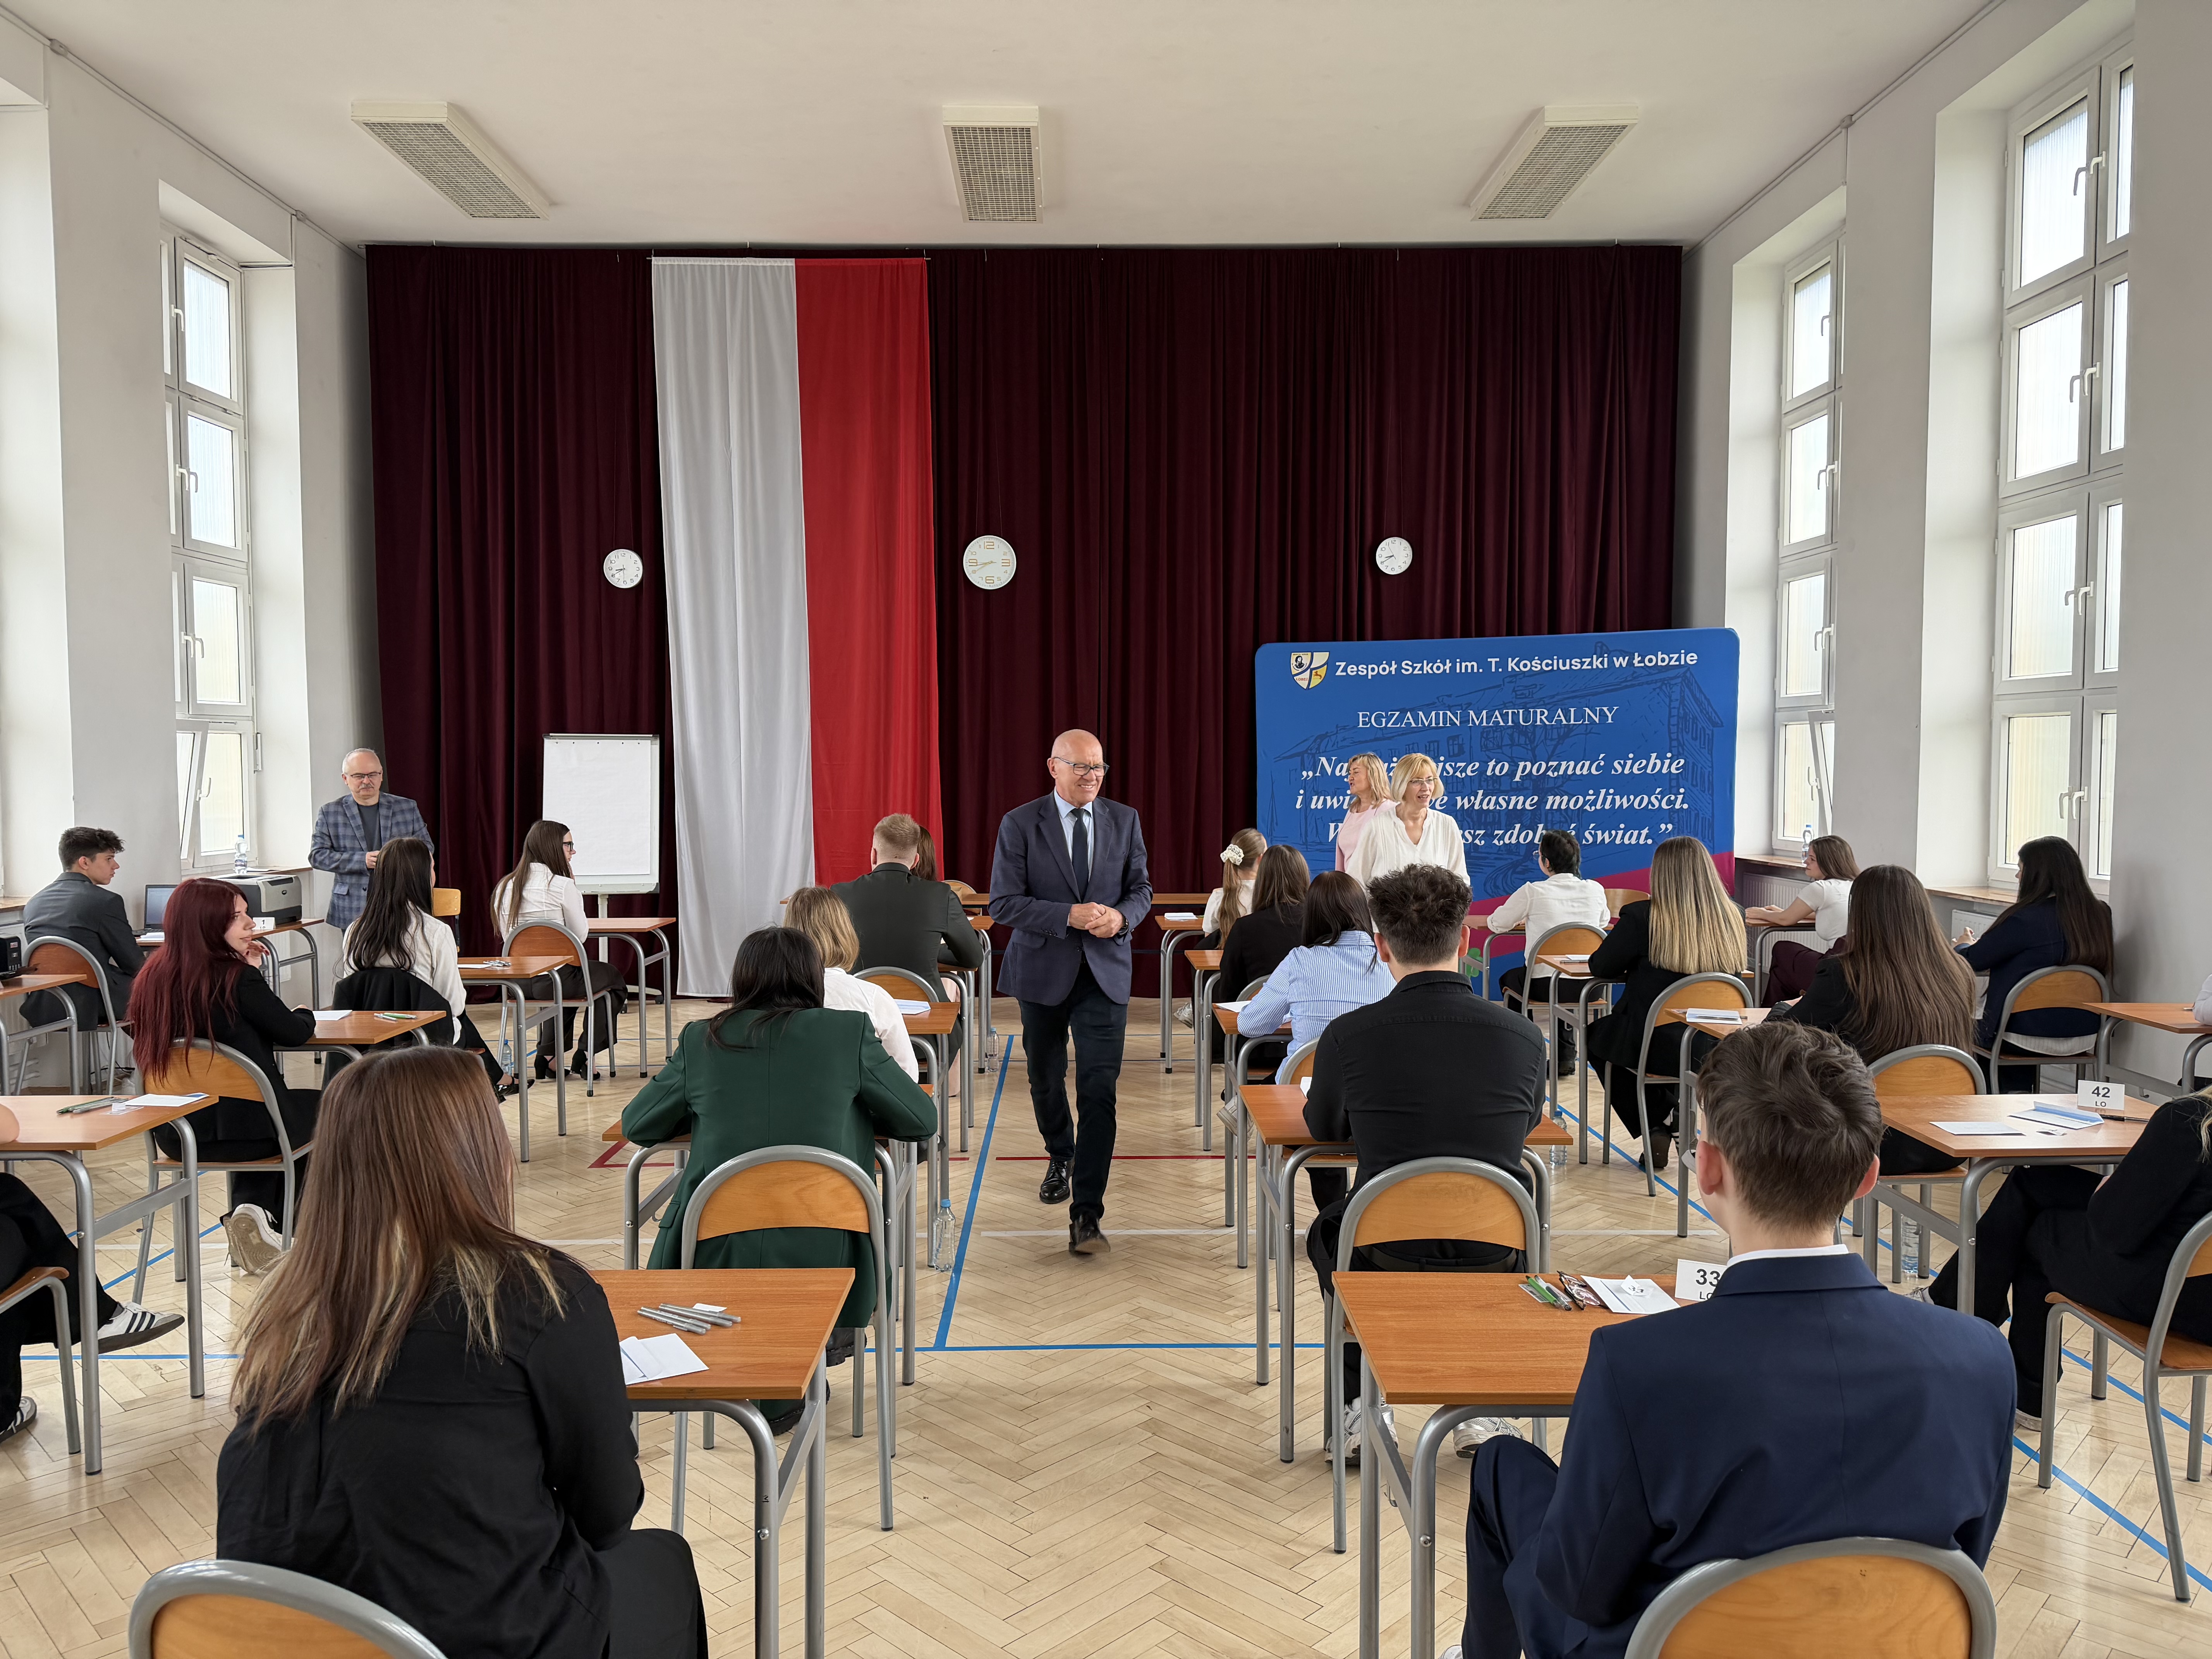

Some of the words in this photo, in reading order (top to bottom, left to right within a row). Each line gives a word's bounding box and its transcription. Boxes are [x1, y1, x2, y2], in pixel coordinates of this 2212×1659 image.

[1335, 661, 1397, 679] Zespół
[1401, 659, 1451, 674] Szkół
[1456, 659, 1483, 673] im.
[1487, 658, 1502, 672] T.
[1508, 654, 1608, 672] Kościuszki
[1613, 656, 1629, 668] w
[1633, 650, 1698, 667] Łobzie
[1357, 710, 1462, 728] EGZAMIN
[1467, 706, 1619, 726] MATURALNY
[1487, 758, 1509, 776] to
[1513, 754, 1606, 781] poznać
[1611, 752, 1685, 775] siebie
[1295, 790, 1304, 809] i
[1455, 790, 1538, 810] własne
[1545, 788, 1688, 811] możliwości.
[2092, 1086, 2110, 1098] 42
[1695, 1269, 1721, 1287] 33
